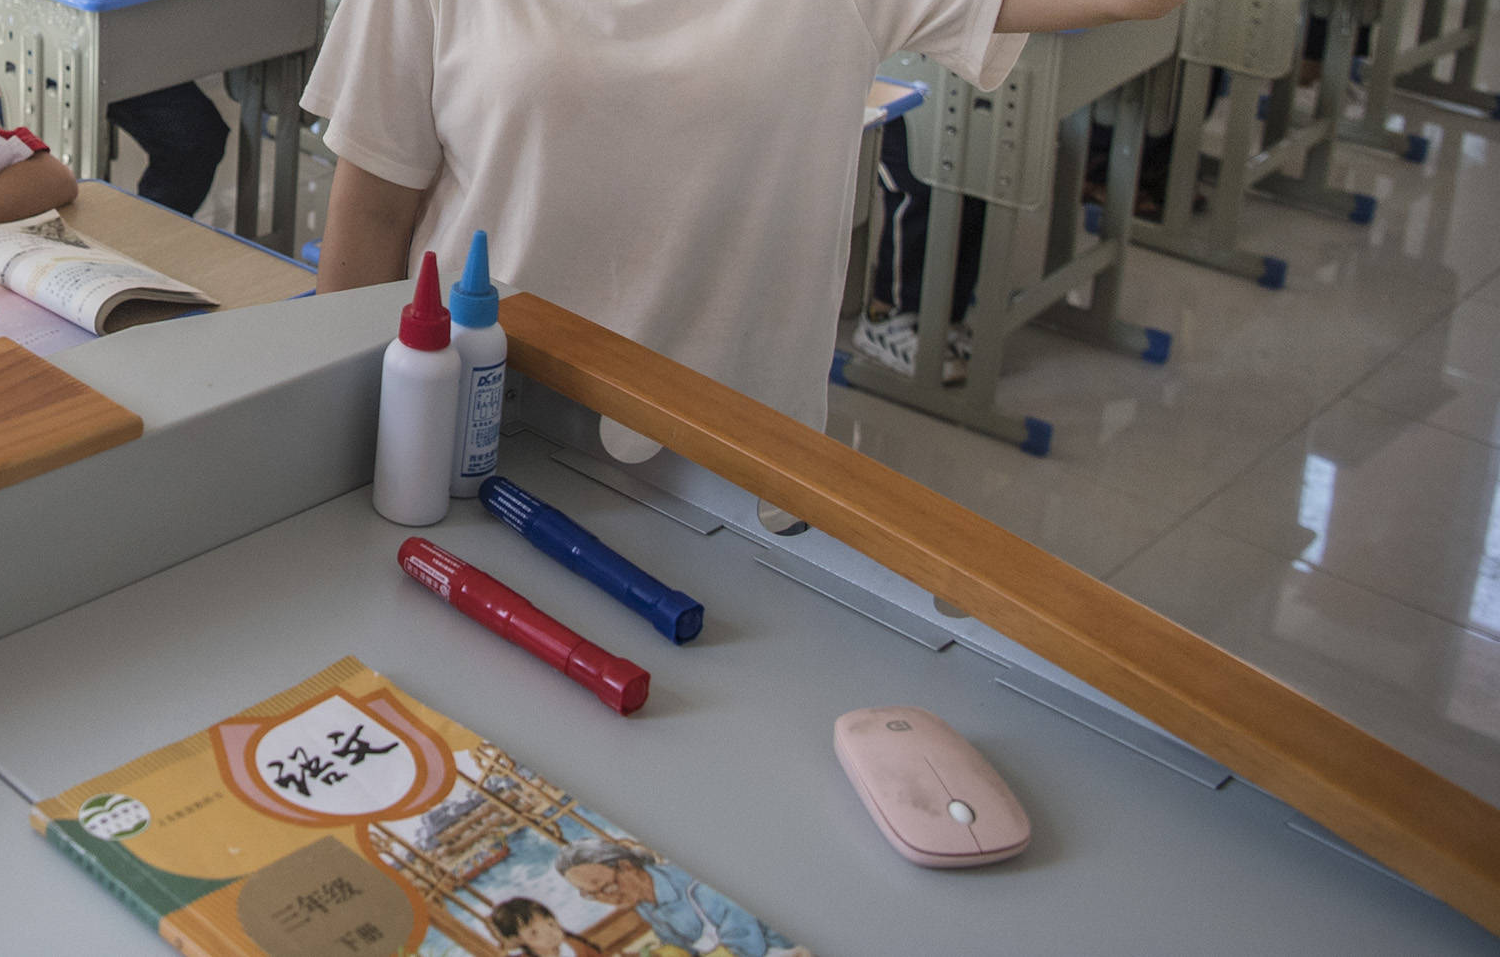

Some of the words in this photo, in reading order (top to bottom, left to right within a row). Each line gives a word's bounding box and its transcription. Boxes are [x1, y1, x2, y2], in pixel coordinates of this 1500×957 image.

[267, 724, 399, 797] 语文
[271, 877, 363, 933] 三年级
[337, 922, 384, 952] 下册
